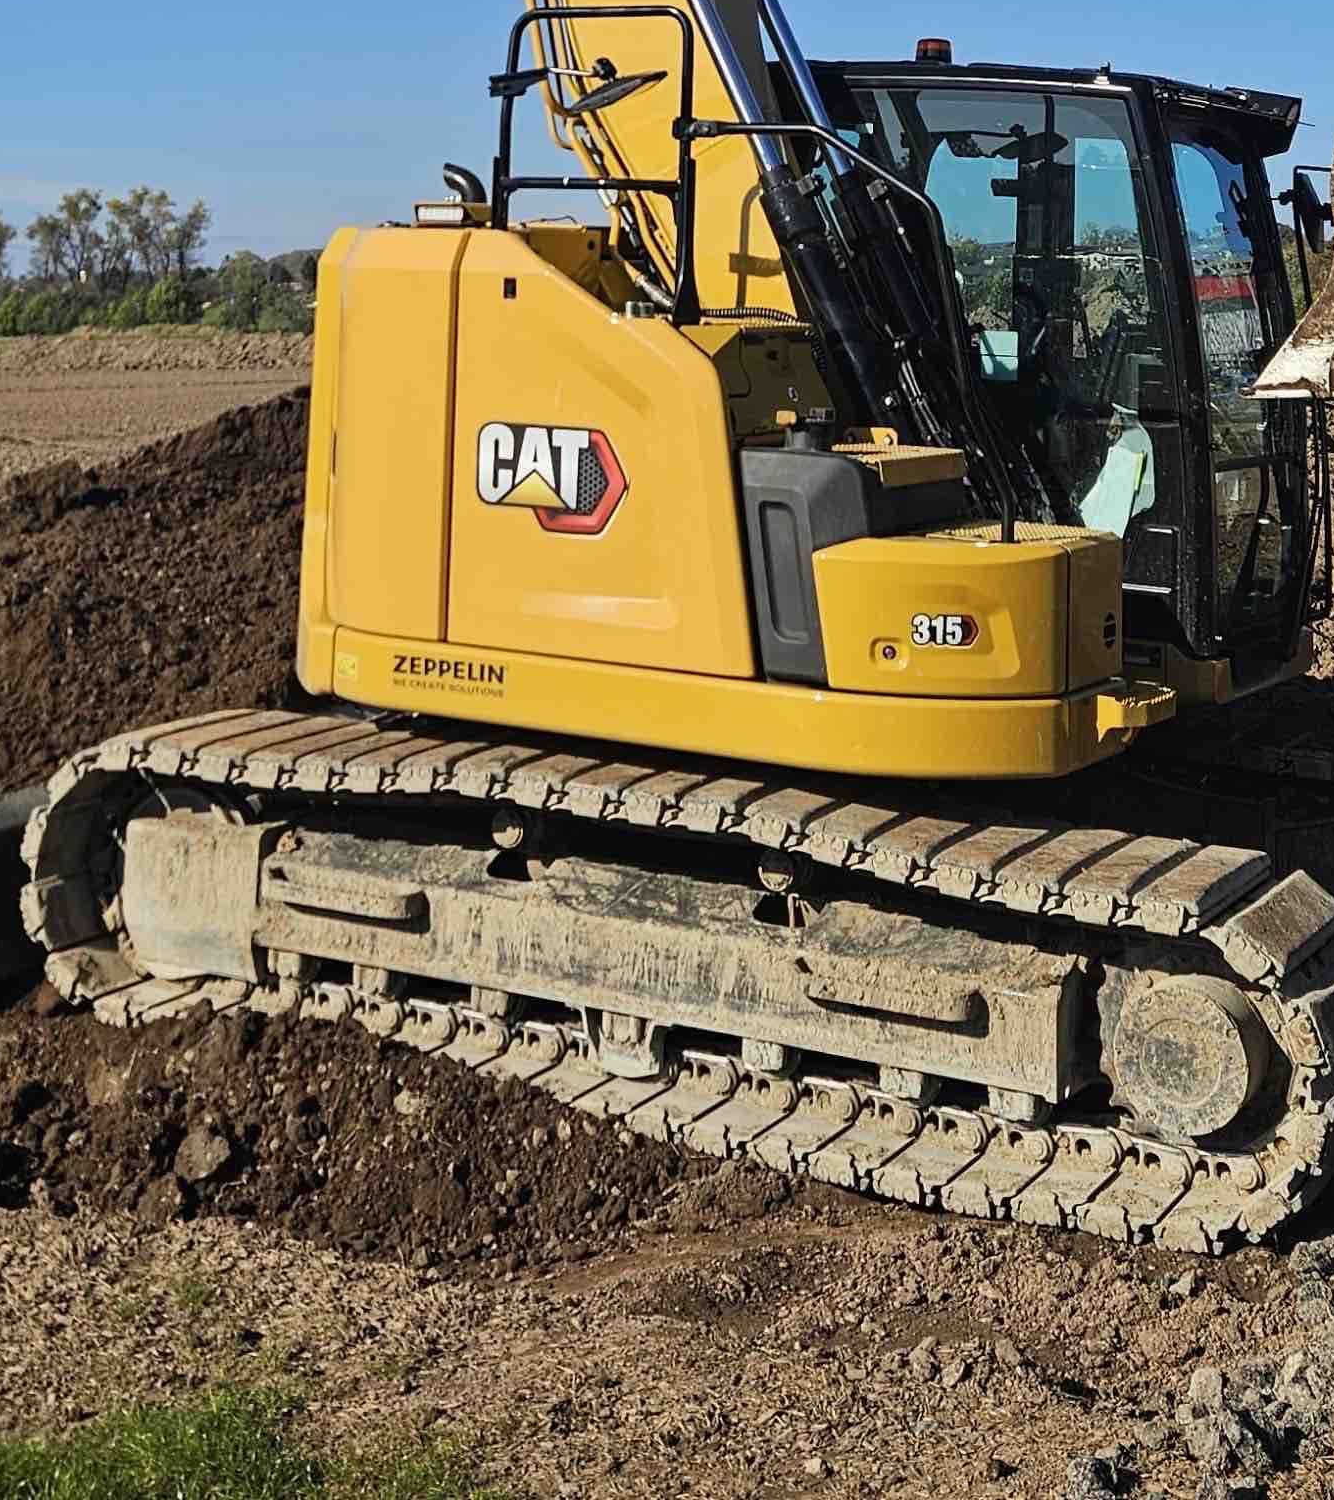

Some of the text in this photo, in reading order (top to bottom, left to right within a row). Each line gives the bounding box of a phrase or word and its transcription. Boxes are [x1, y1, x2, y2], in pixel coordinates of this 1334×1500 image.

[478, 422, 590, 510] CAT
[912, 613, 963, 645] 315
[393, 654, 505, 685] ZEPPELIN
